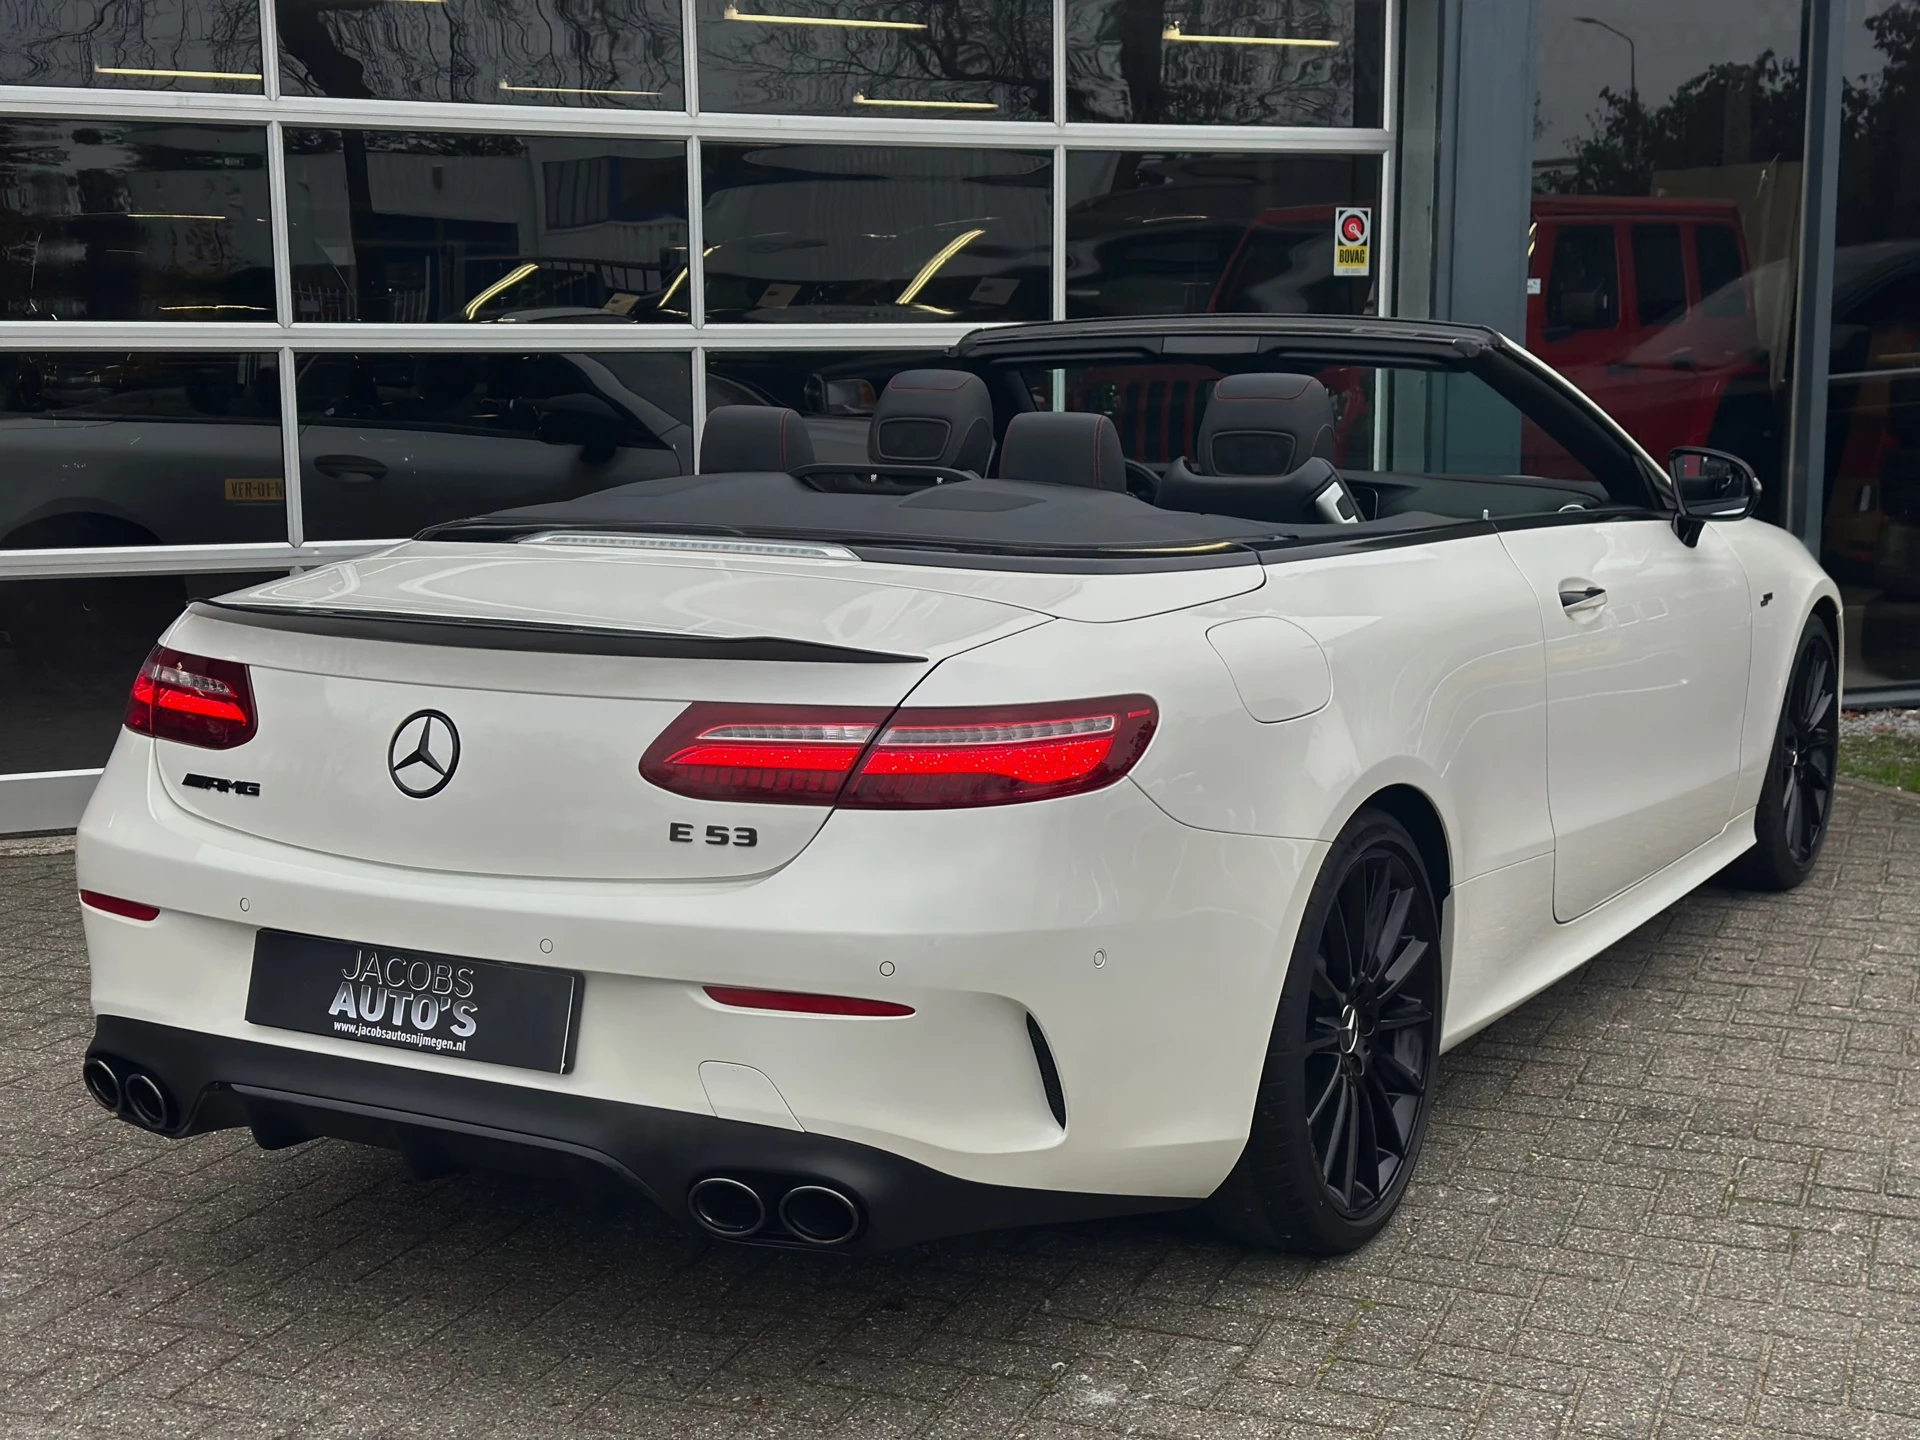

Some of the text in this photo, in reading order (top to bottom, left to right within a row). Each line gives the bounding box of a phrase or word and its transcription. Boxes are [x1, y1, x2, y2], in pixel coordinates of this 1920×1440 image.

[1339, 249, 1365, 264] BOVAG
[200, 776, 260, 797] AMG
[669, 822, 757, 847] E 53
[342, 950, 474, 998] JACOBS
[328, 981, 478, 1037] AUTO'S
[333, 1021, 466, 1052] www.jacobsautosnijmegen.nl
